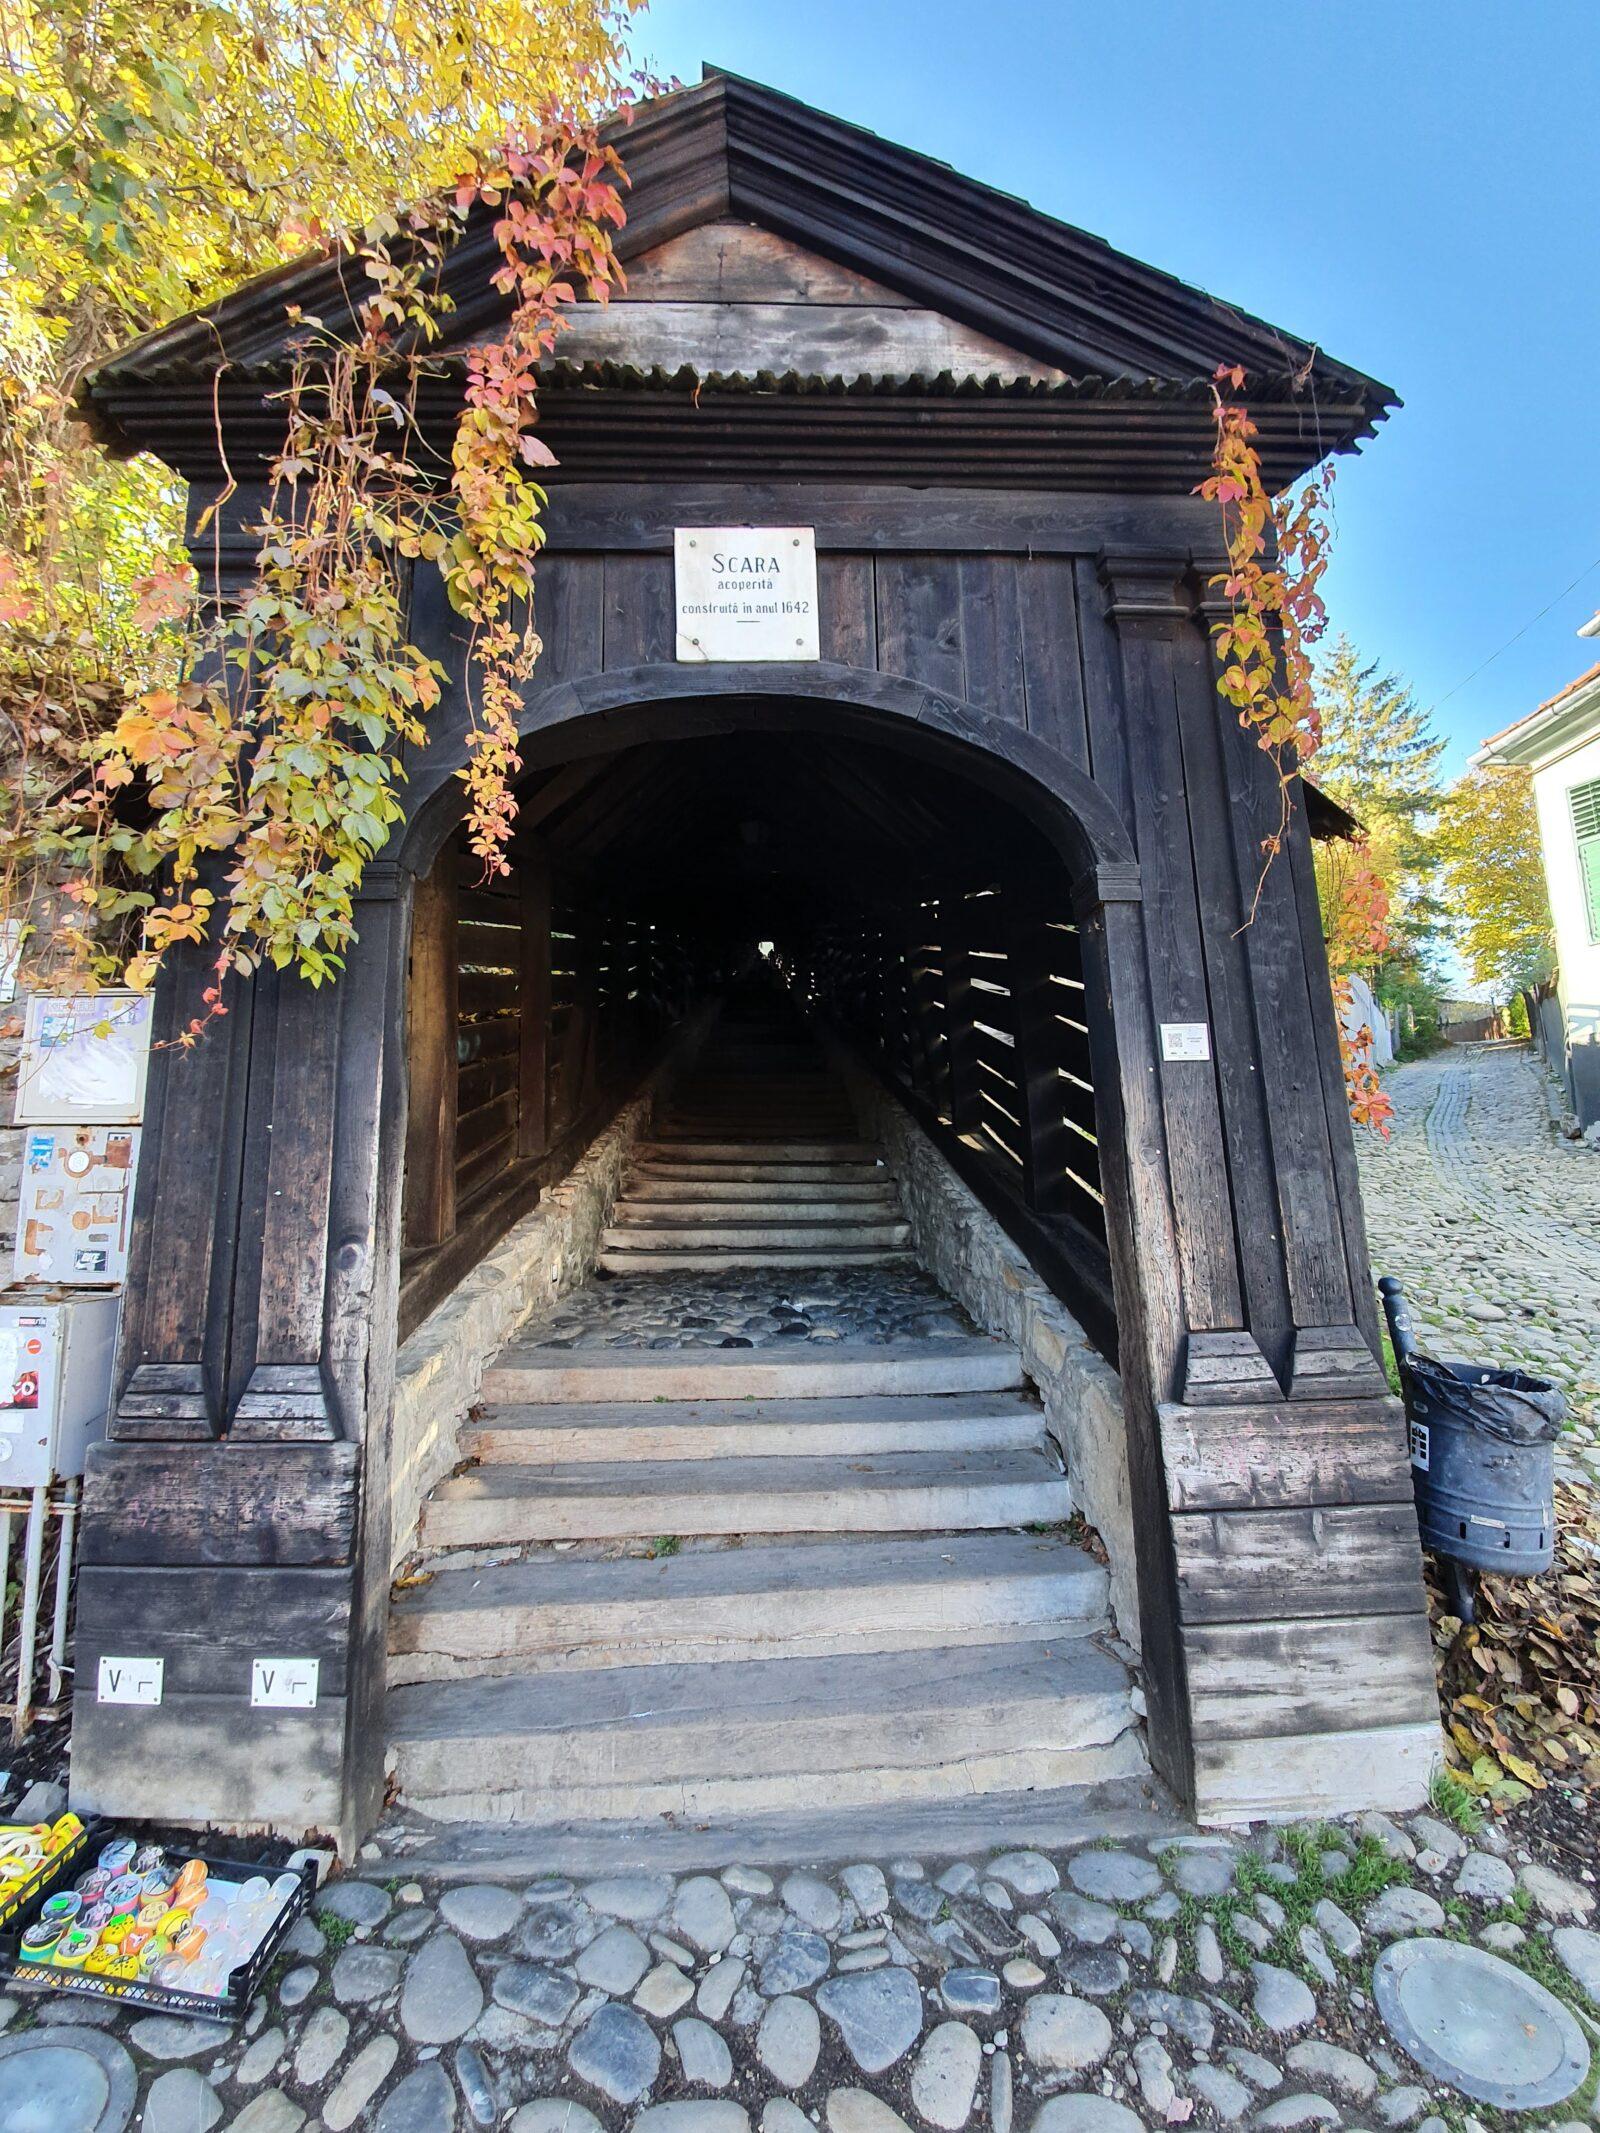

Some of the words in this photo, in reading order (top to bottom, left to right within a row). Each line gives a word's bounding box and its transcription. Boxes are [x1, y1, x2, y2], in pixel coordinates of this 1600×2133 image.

[712, 553, 780, 573] SCARA
[755, 602, 778, 613] anul
[782, 601, 809, 613] 1642
[109, 1669, 121, 1692] V
[262, 1670, 275, 1694] V
